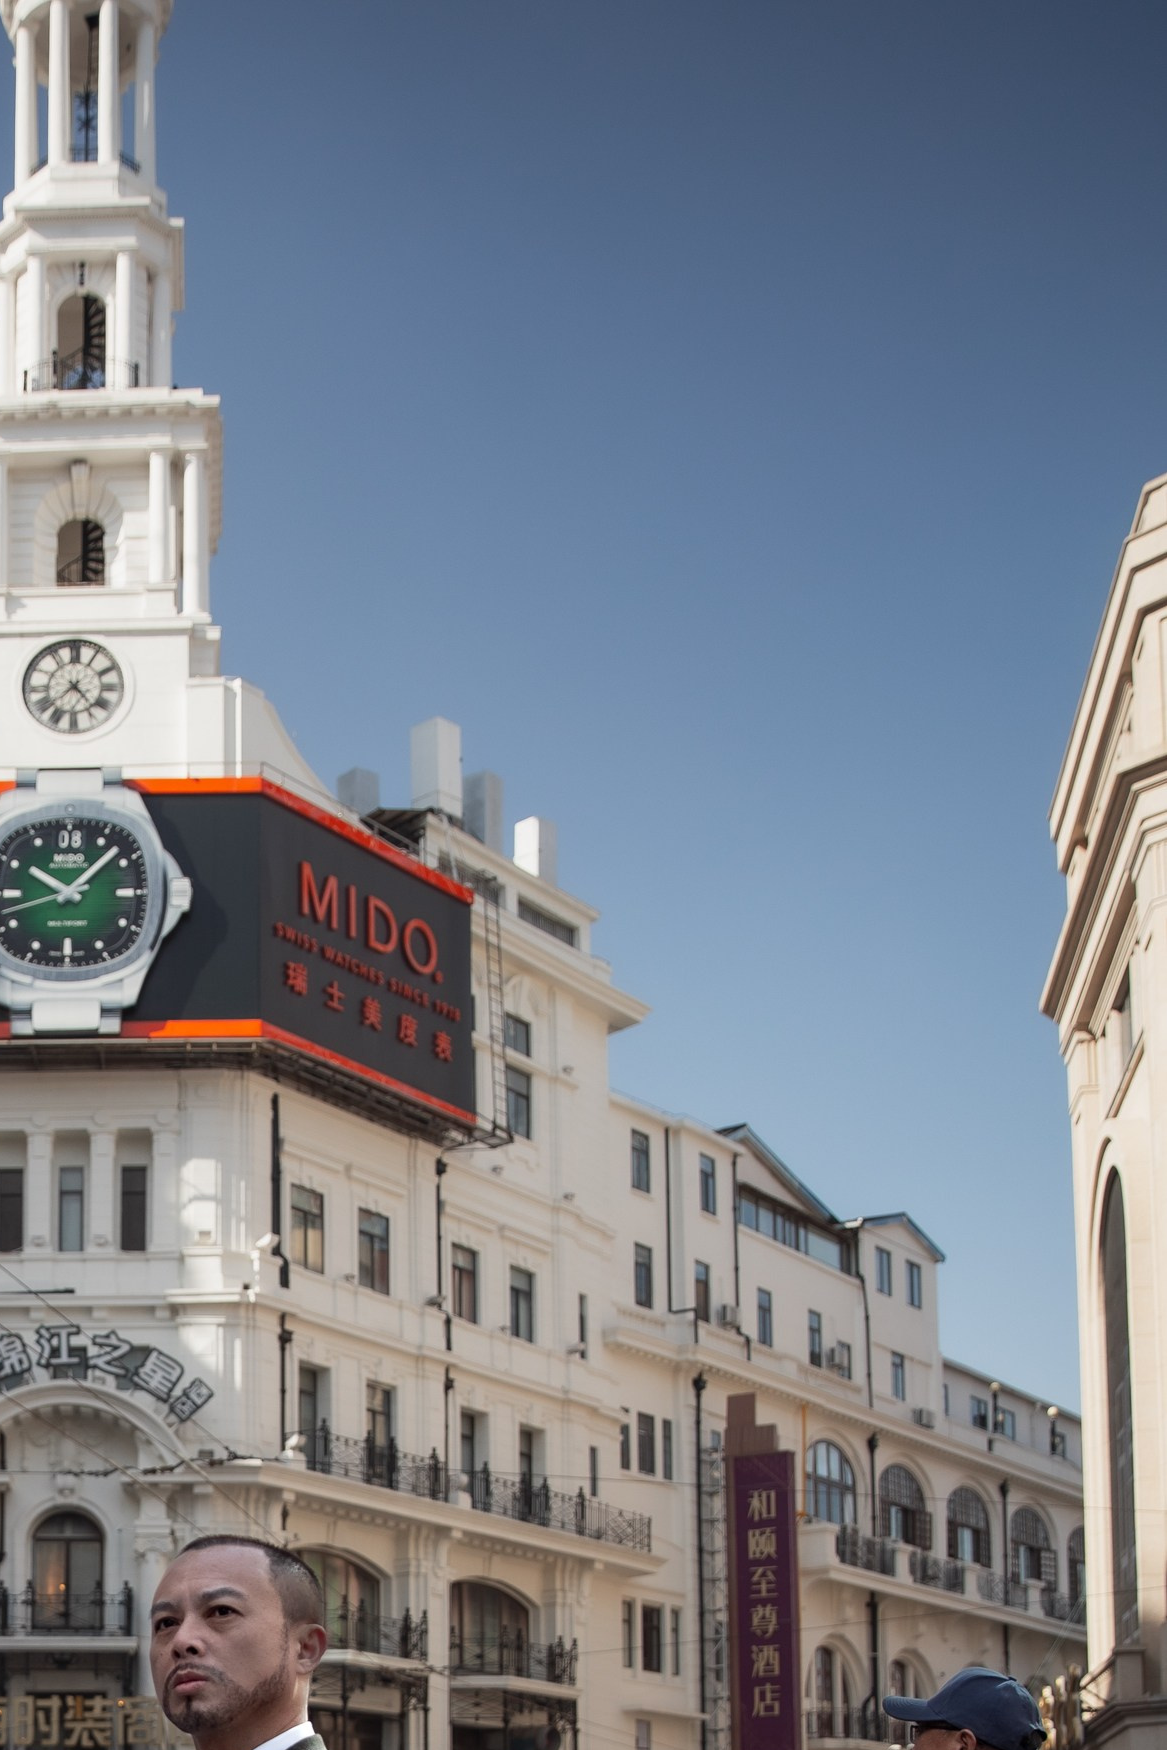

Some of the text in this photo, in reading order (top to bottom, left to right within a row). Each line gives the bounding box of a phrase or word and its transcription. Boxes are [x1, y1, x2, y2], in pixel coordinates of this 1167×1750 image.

[58, 829, 82, 849] 08
[274, 921, 319, 953] SWISS
[322, 943, 385, 985] WATCHES
[300, 860, 438, 975] MIDO
[286, 960, 453, 1063] 瑞士美度表
[746, 1488, 781, 1718] 和颐至尊酒店
